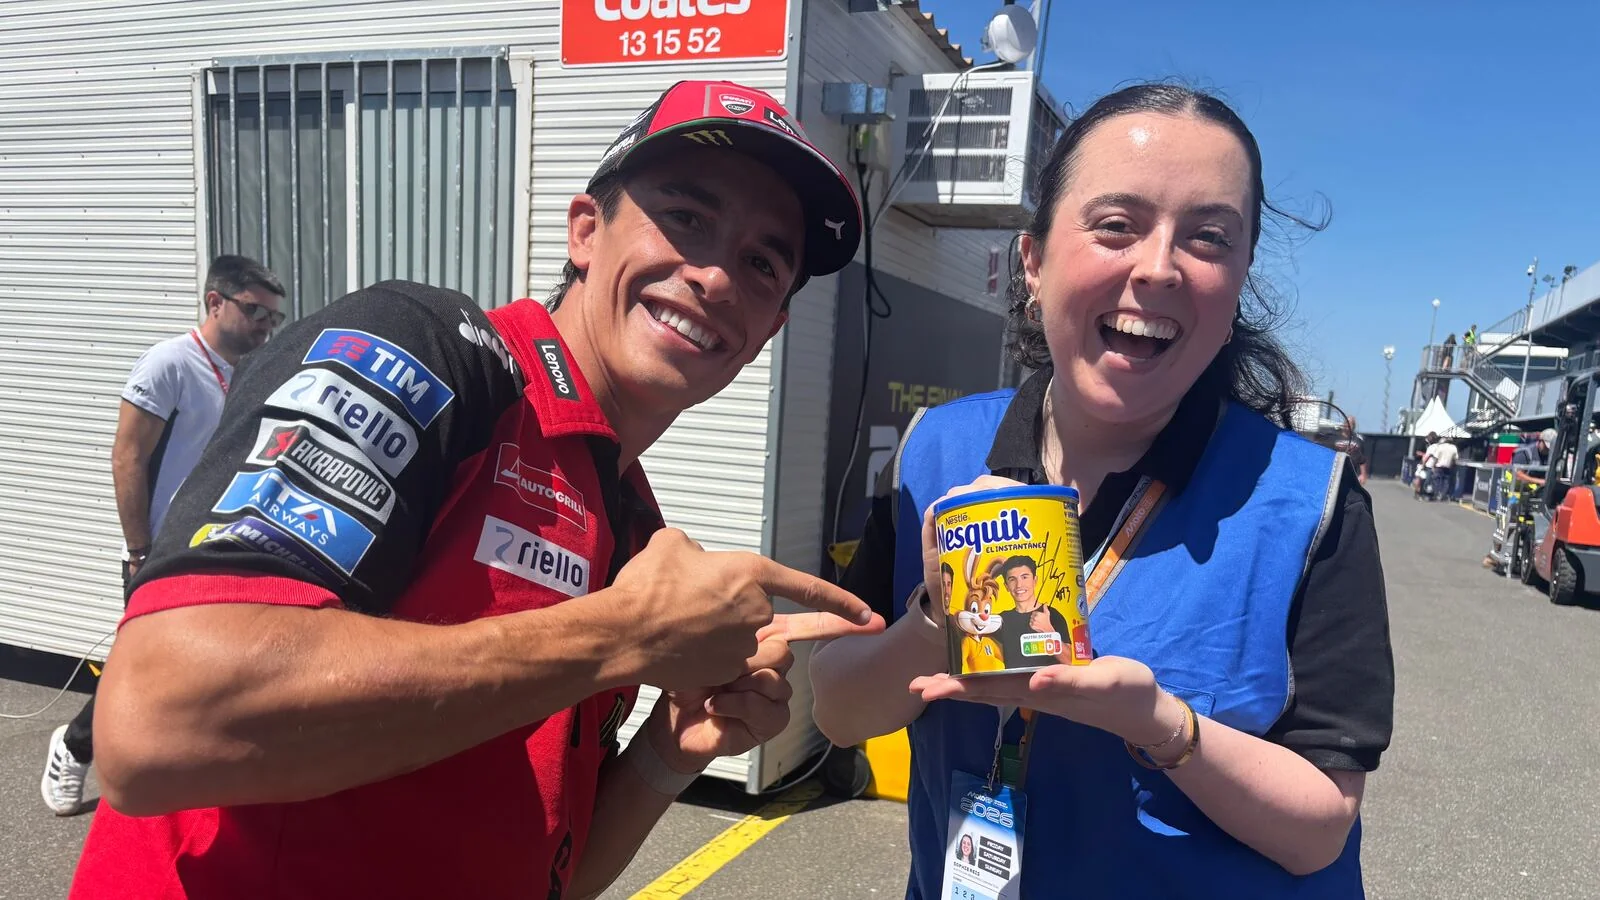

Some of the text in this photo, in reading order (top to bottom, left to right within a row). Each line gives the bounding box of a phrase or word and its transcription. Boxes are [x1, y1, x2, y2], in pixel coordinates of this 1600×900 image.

[619, 27, 722, 56] 13 15 52
[769, 111, 795, 136] Len
[368, 347, 431, 405] TIM
[541, 344, 570, 395] Lenovo
[316, 384, 408, 458] riello
[249, 493, 330, 545] AIRWAYS
[519, 477, 584, 517] AUTOGRILL
[937, 509, 1031, 555] Nesquik
[517, 541, 583, 588] riello
[960, 797, 1014, 828] 2026
